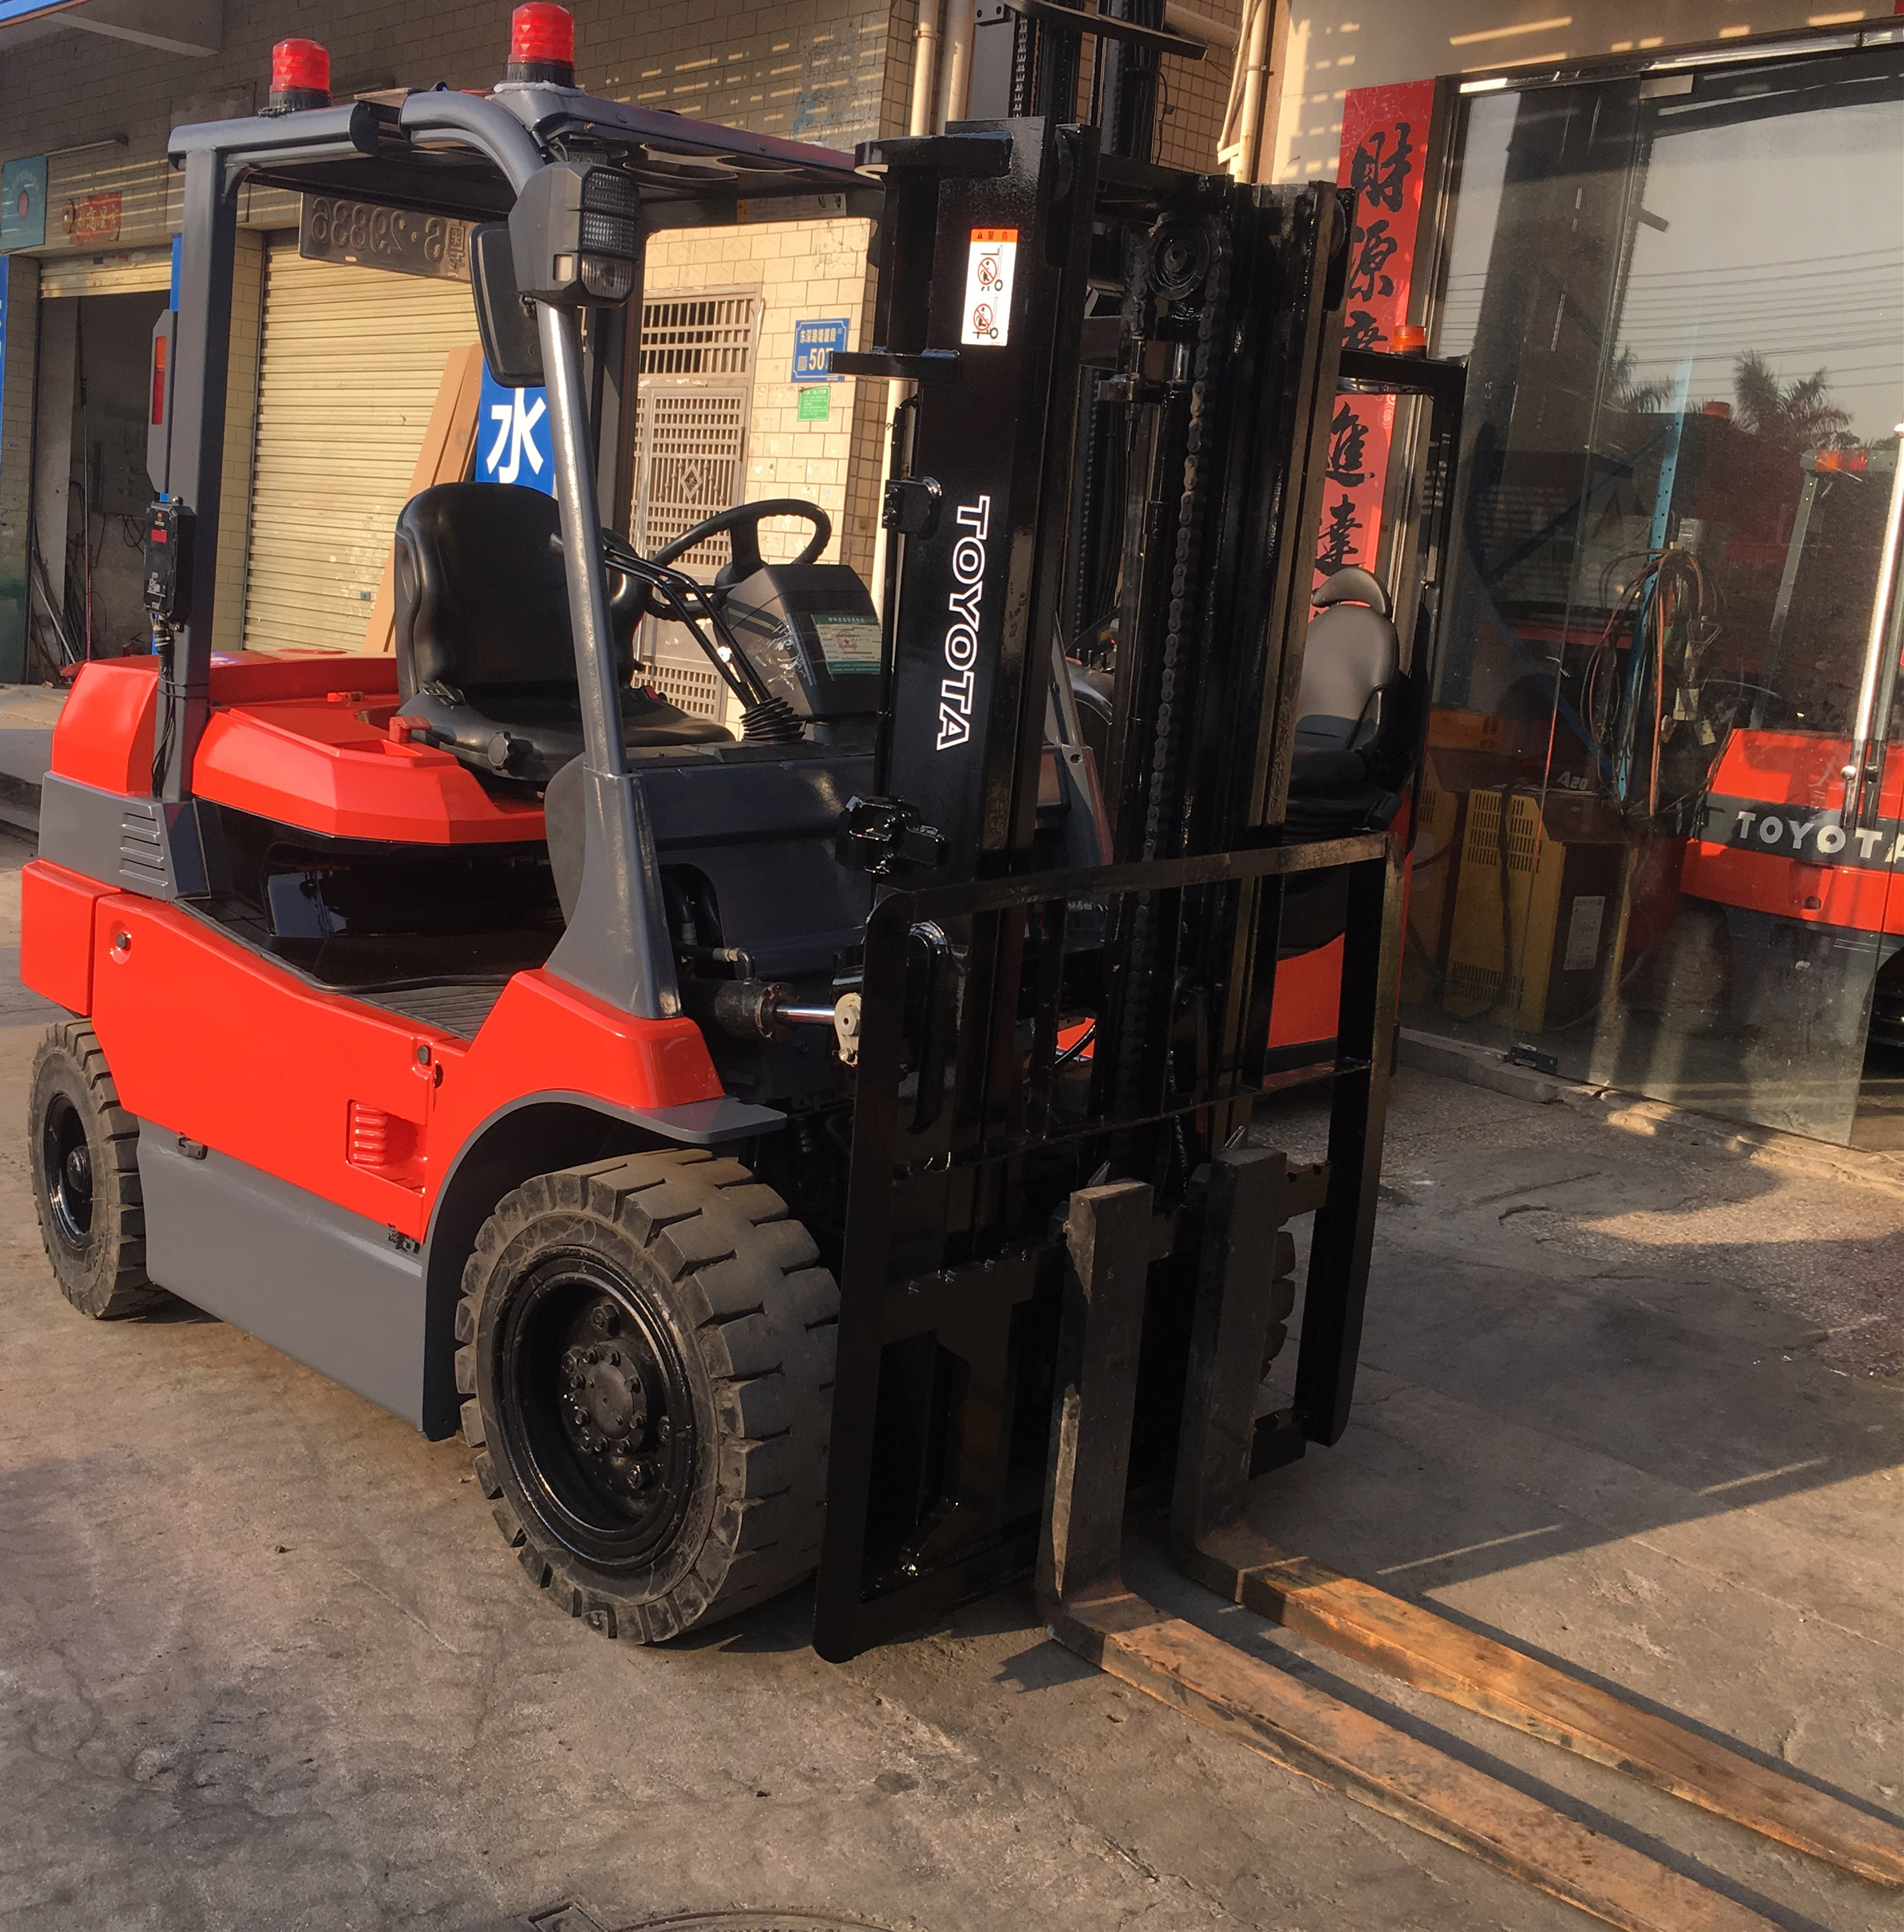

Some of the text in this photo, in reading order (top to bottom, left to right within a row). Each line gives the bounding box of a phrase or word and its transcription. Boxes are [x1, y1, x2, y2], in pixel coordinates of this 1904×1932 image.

[987, 231, 1009, 241] 警告
[486, 388, 546, 483] 水
[937, 495, 990, 750] TOYOTA
